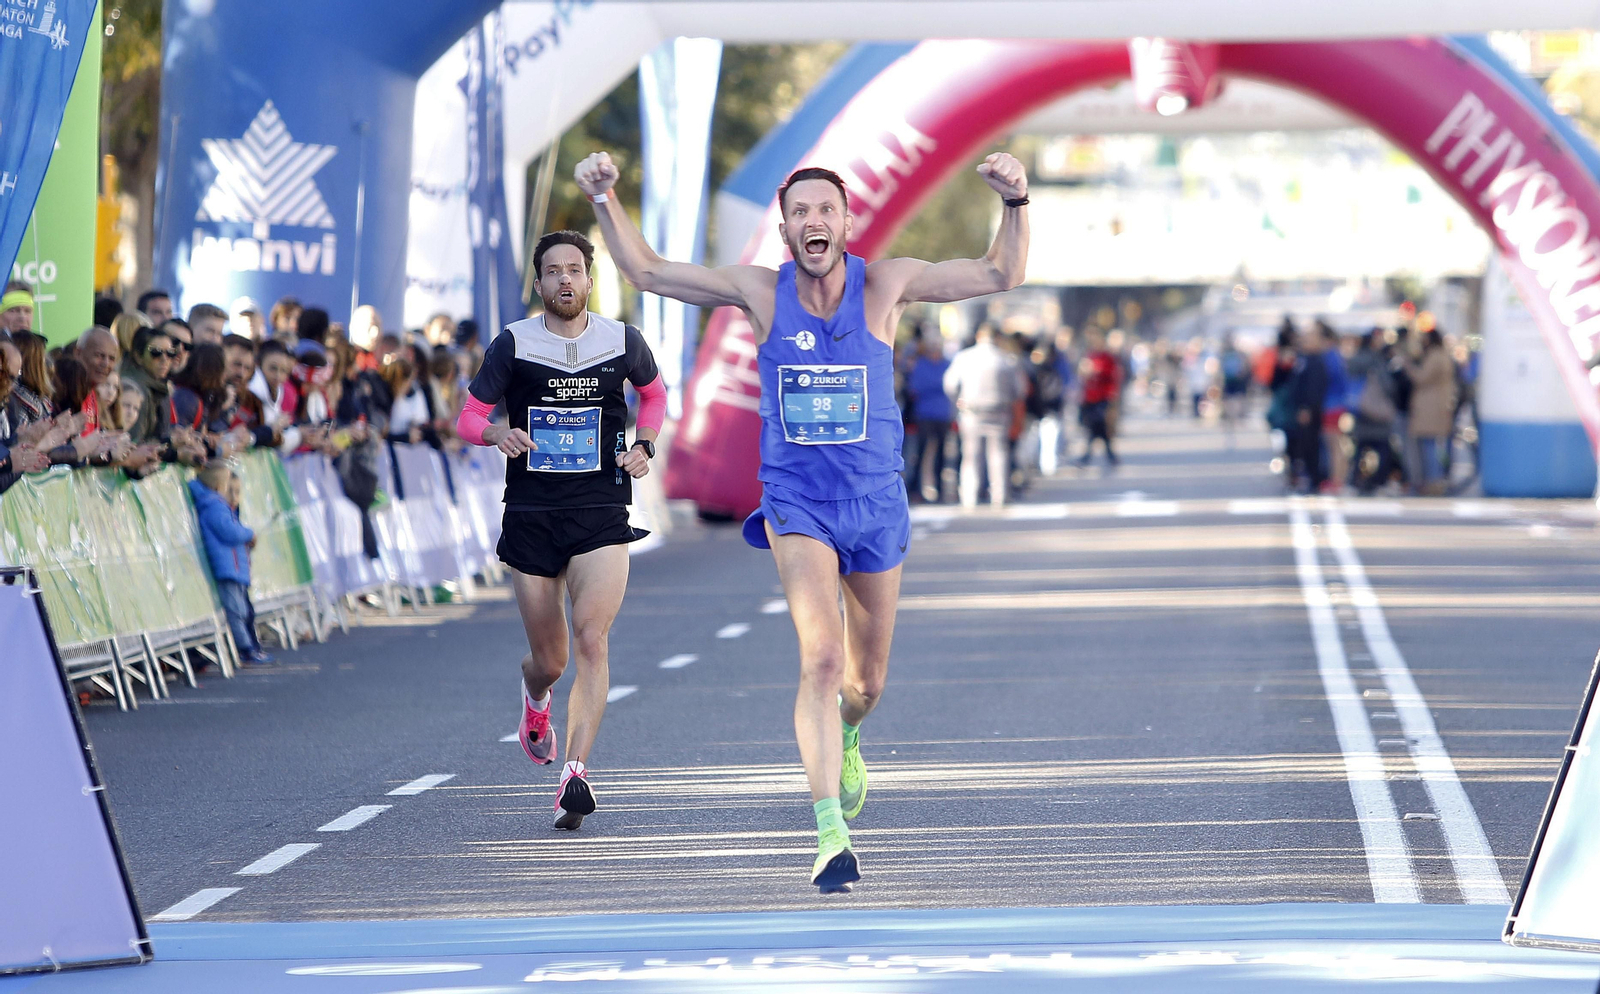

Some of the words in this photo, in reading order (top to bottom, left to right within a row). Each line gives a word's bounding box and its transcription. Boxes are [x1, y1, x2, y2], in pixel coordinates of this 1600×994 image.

[812, 376, 847, 384] ZURICH
[812, 397, 832, 412] 98
[558, 433, 574, 445] 78
